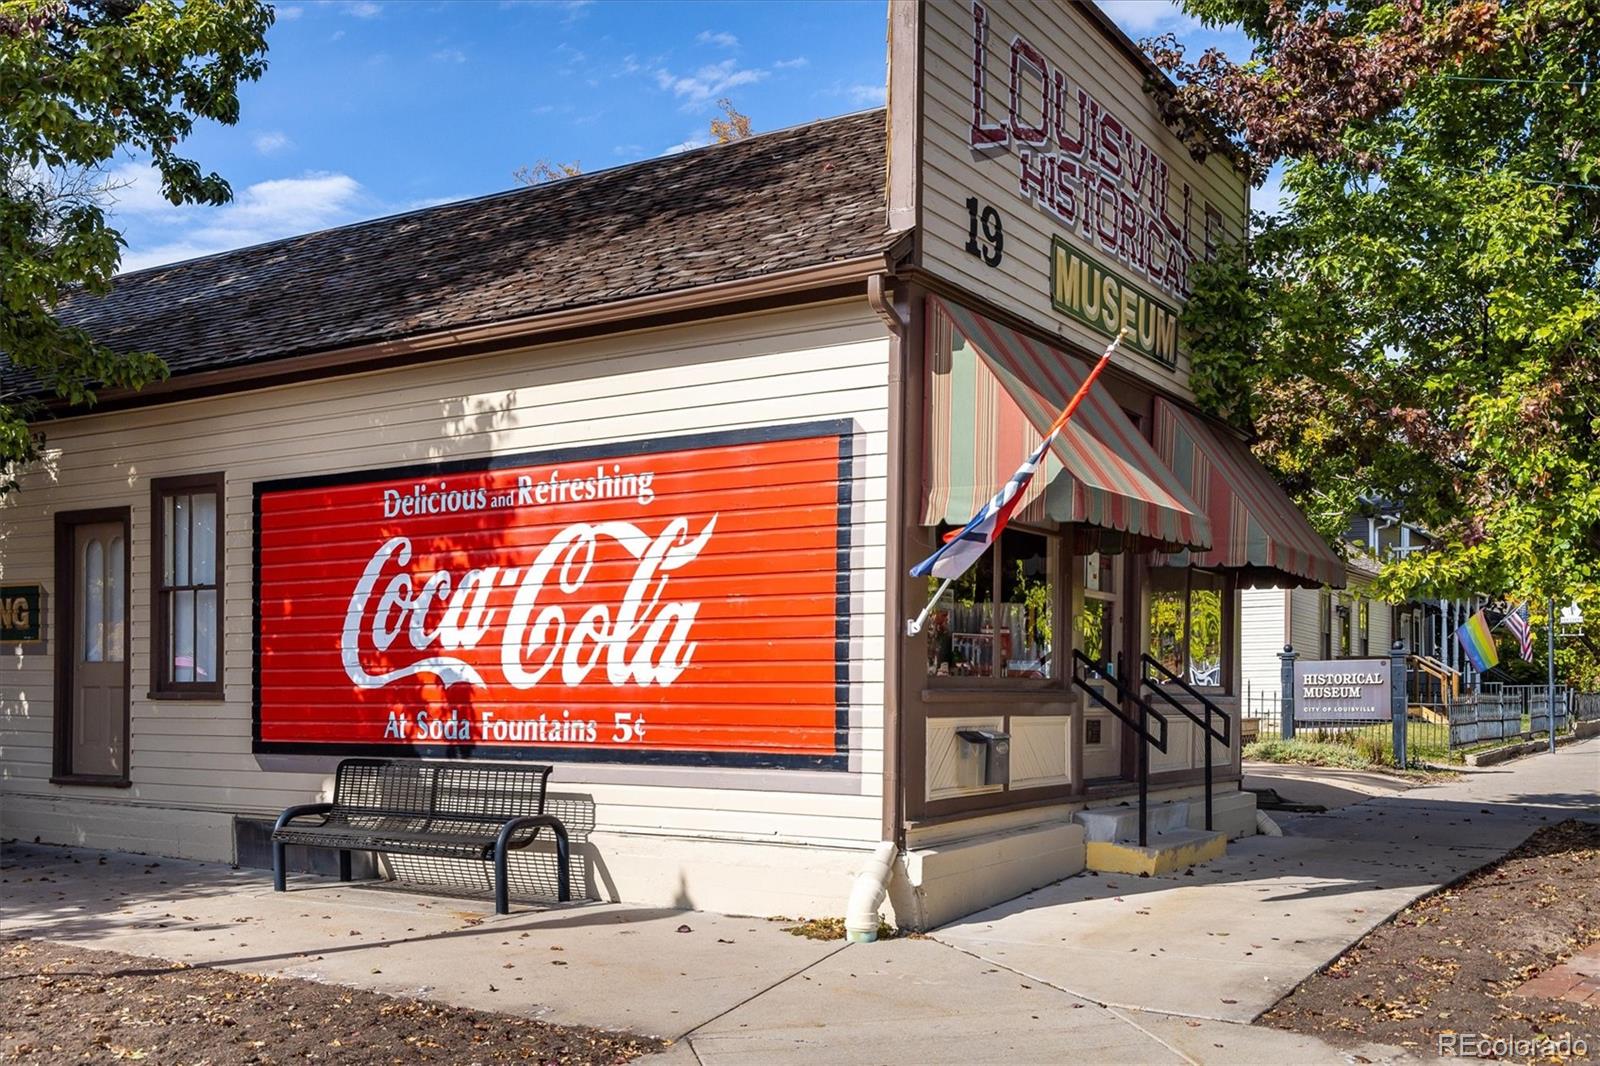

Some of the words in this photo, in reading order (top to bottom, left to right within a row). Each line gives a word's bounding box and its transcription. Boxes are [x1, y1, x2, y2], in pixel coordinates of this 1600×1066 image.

[965, 197, 1003, 268] 19
[1055, 249, 1177, 364] MUSEUM
[384, 483, 487, 518] Delicious
[490, 493, 514, 508] and
[517, 464, 655, 506] Refreshing
[341, 512, 719, 690] Coca-Cola
[1303, 673, 1384, 685] HISTORICAL
[1303, 687, 1361, 698] MUSEUM
[384, 711, 406, 739] At
[416, 710, 470, 740] Soda
[481, 710, 597, 743] Fountains
[612, 713, 647, 743] 5¢
